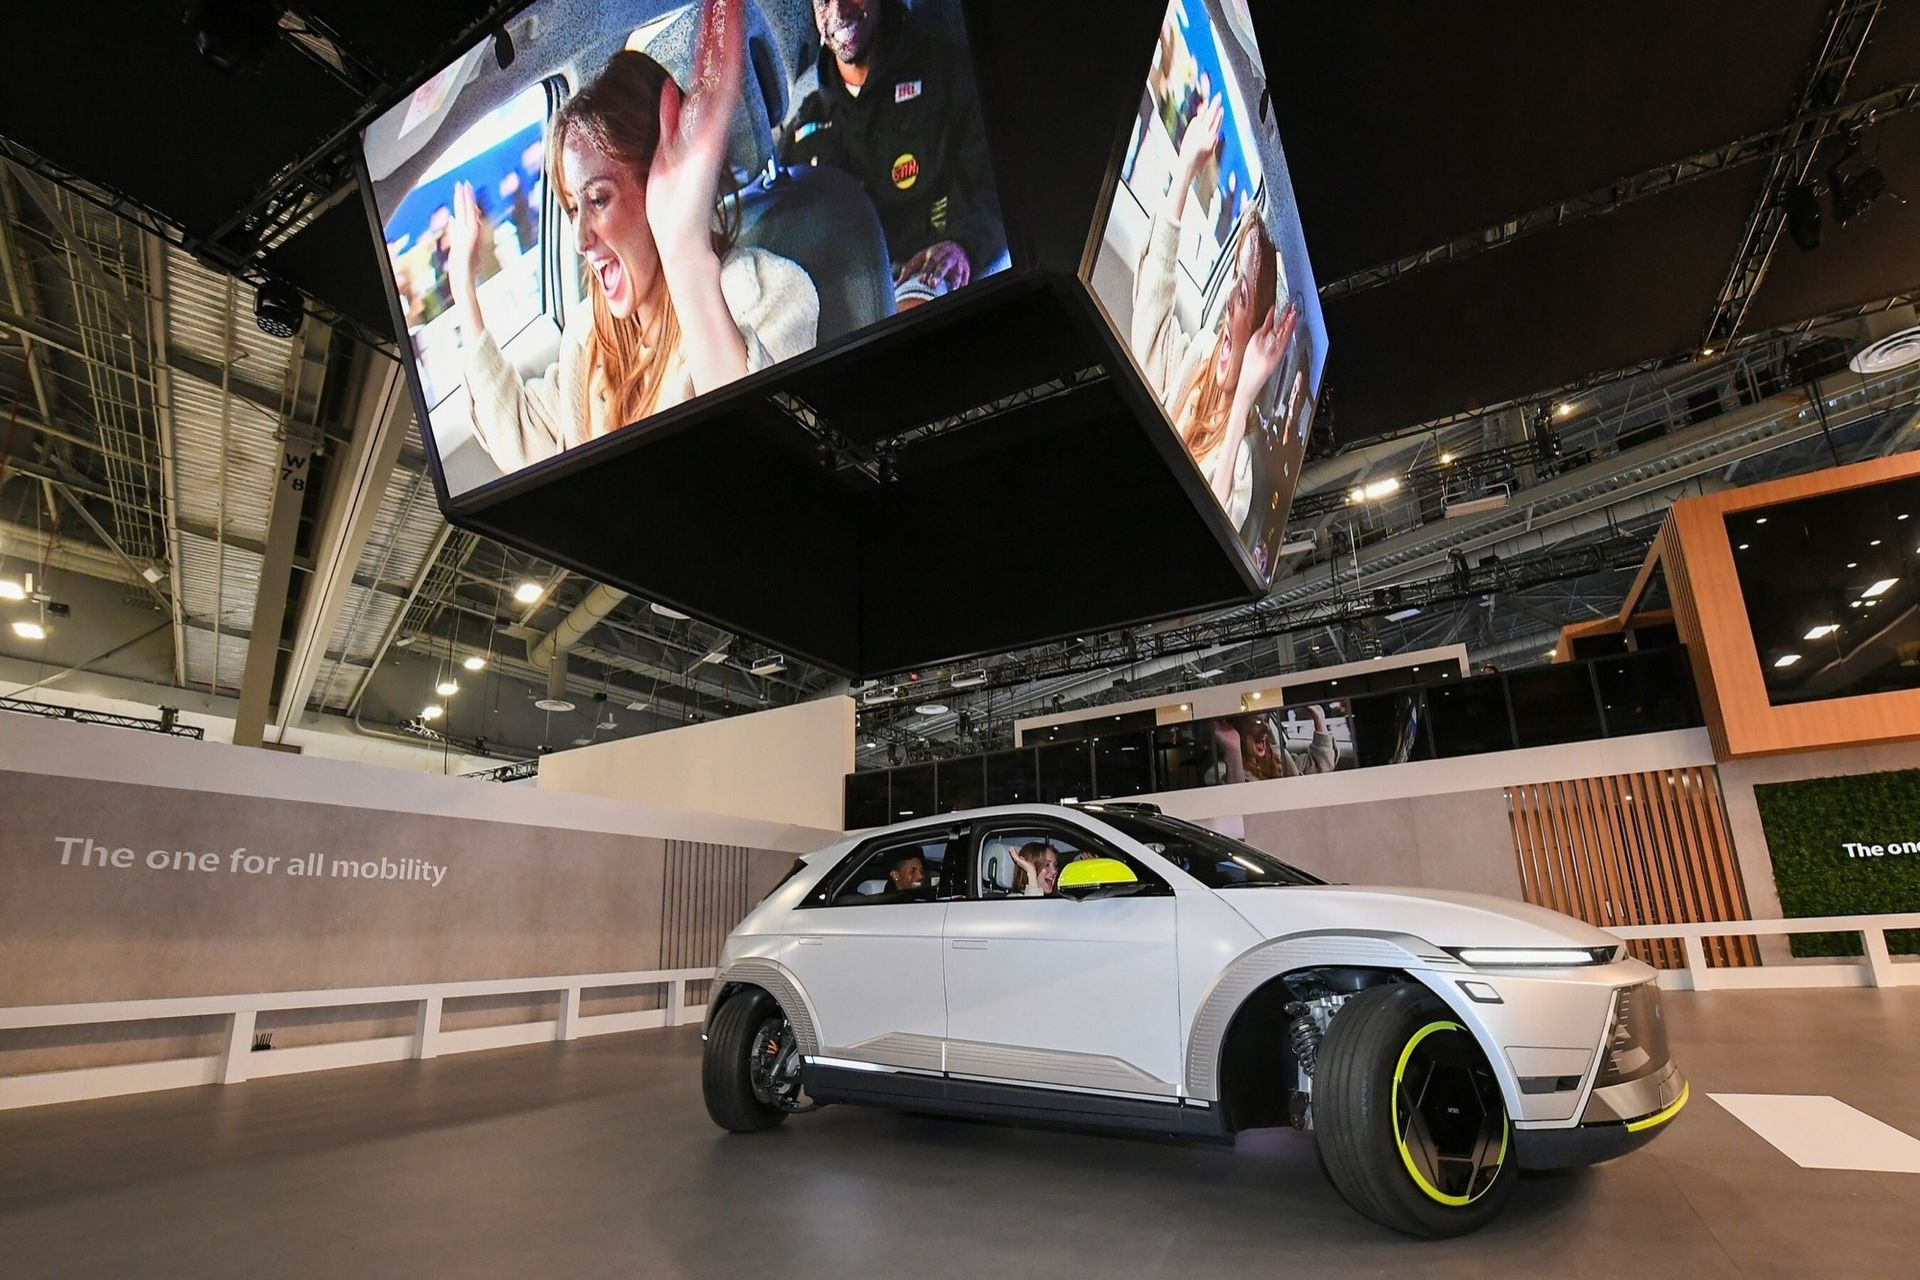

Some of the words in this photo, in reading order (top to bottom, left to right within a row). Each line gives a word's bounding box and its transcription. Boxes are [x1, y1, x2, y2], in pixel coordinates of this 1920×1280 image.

[286, 453, 306, 469] W
[281, 467, 305, 491] 78
[1841, 842, 1885, 858] The
[54, 836, 135, 868] The
[146, 849, 220, 872] one
[229, 848, 281, 874] for
[286, 852, 324, 877] all
[331, 857, 448, 887] mobility
